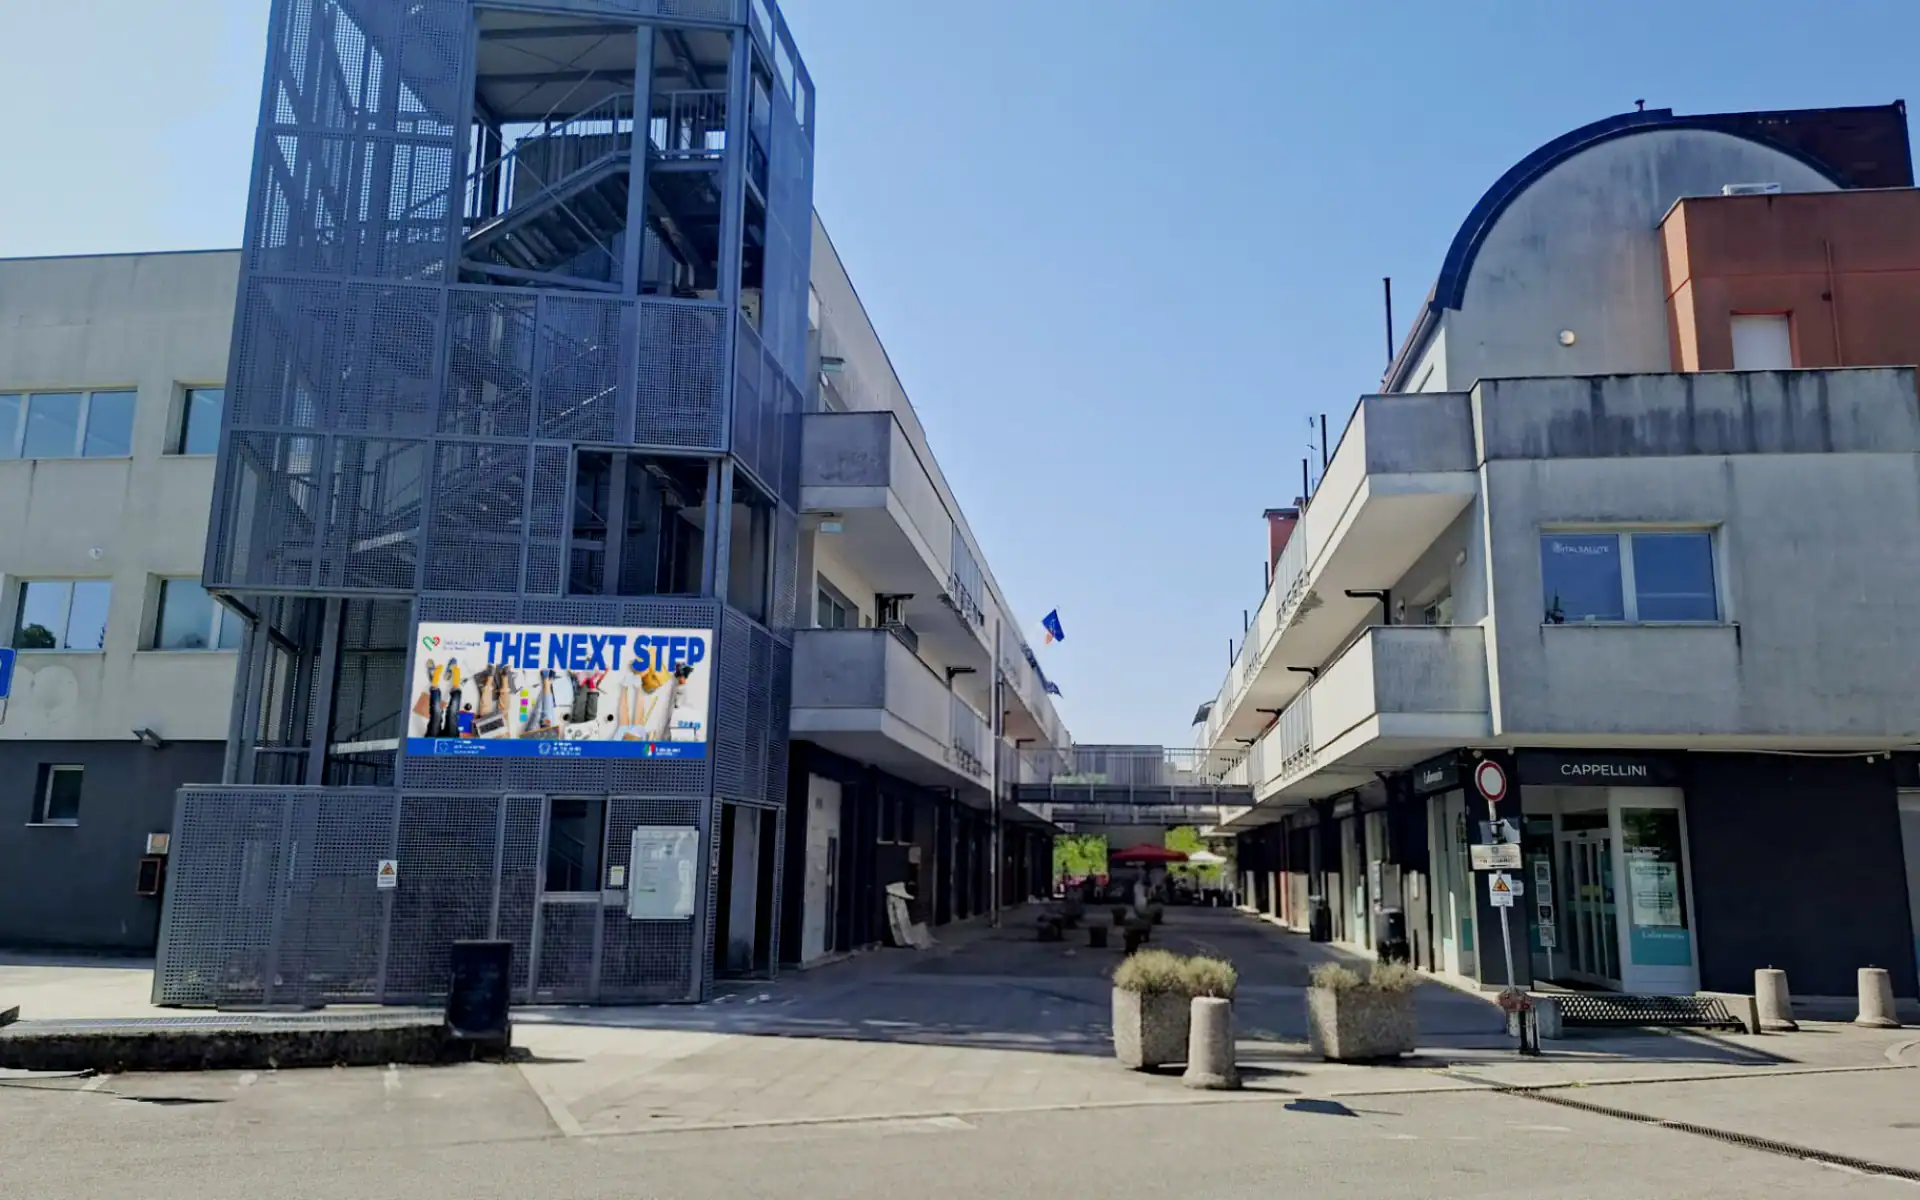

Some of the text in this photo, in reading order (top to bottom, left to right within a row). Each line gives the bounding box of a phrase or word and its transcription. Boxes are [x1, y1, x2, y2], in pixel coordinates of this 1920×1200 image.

[484, 631, 705, 673] THE NEXT STEP
[1560, 763, 1647, 777] CAPPELLINI
